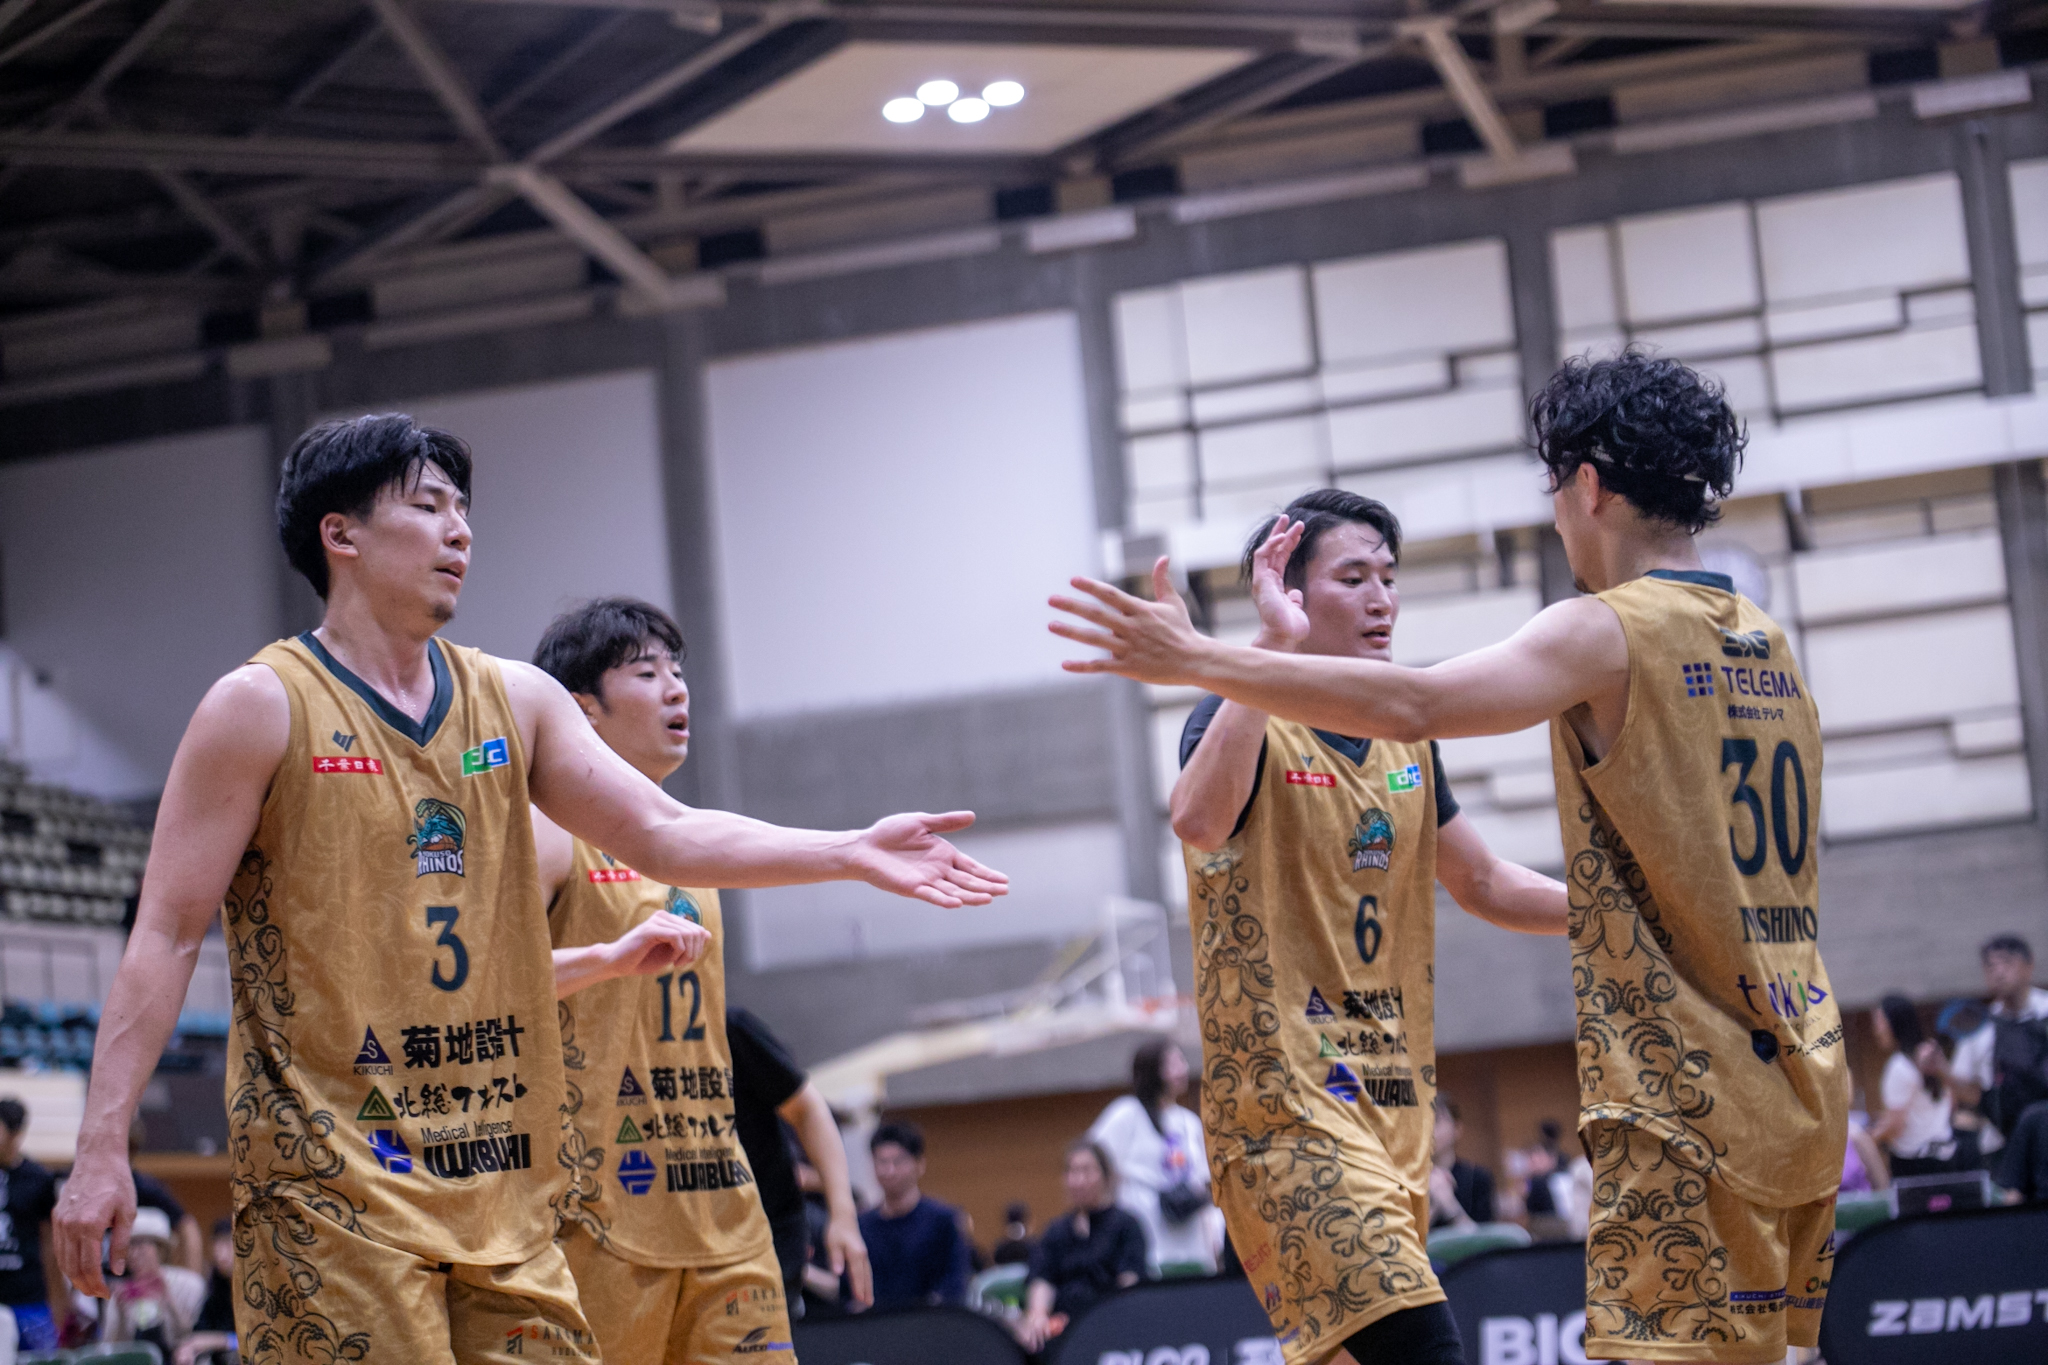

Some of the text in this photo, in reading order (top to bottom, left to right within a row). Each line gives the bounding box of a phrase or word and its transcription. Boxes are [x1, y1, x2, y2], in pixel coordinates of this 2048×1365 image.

[1720, 666, 1801, 699] TELEMA
[1721, 737, 1808, 875] 30
[426, 906, 469, 991] 3
[1354, 894, 1383, 964] 6
[657, 970, 706, 1042] 12
[354, 1065, 393, 1076] KIKUCHI
[421, 1122, 469, 1144] Medical
